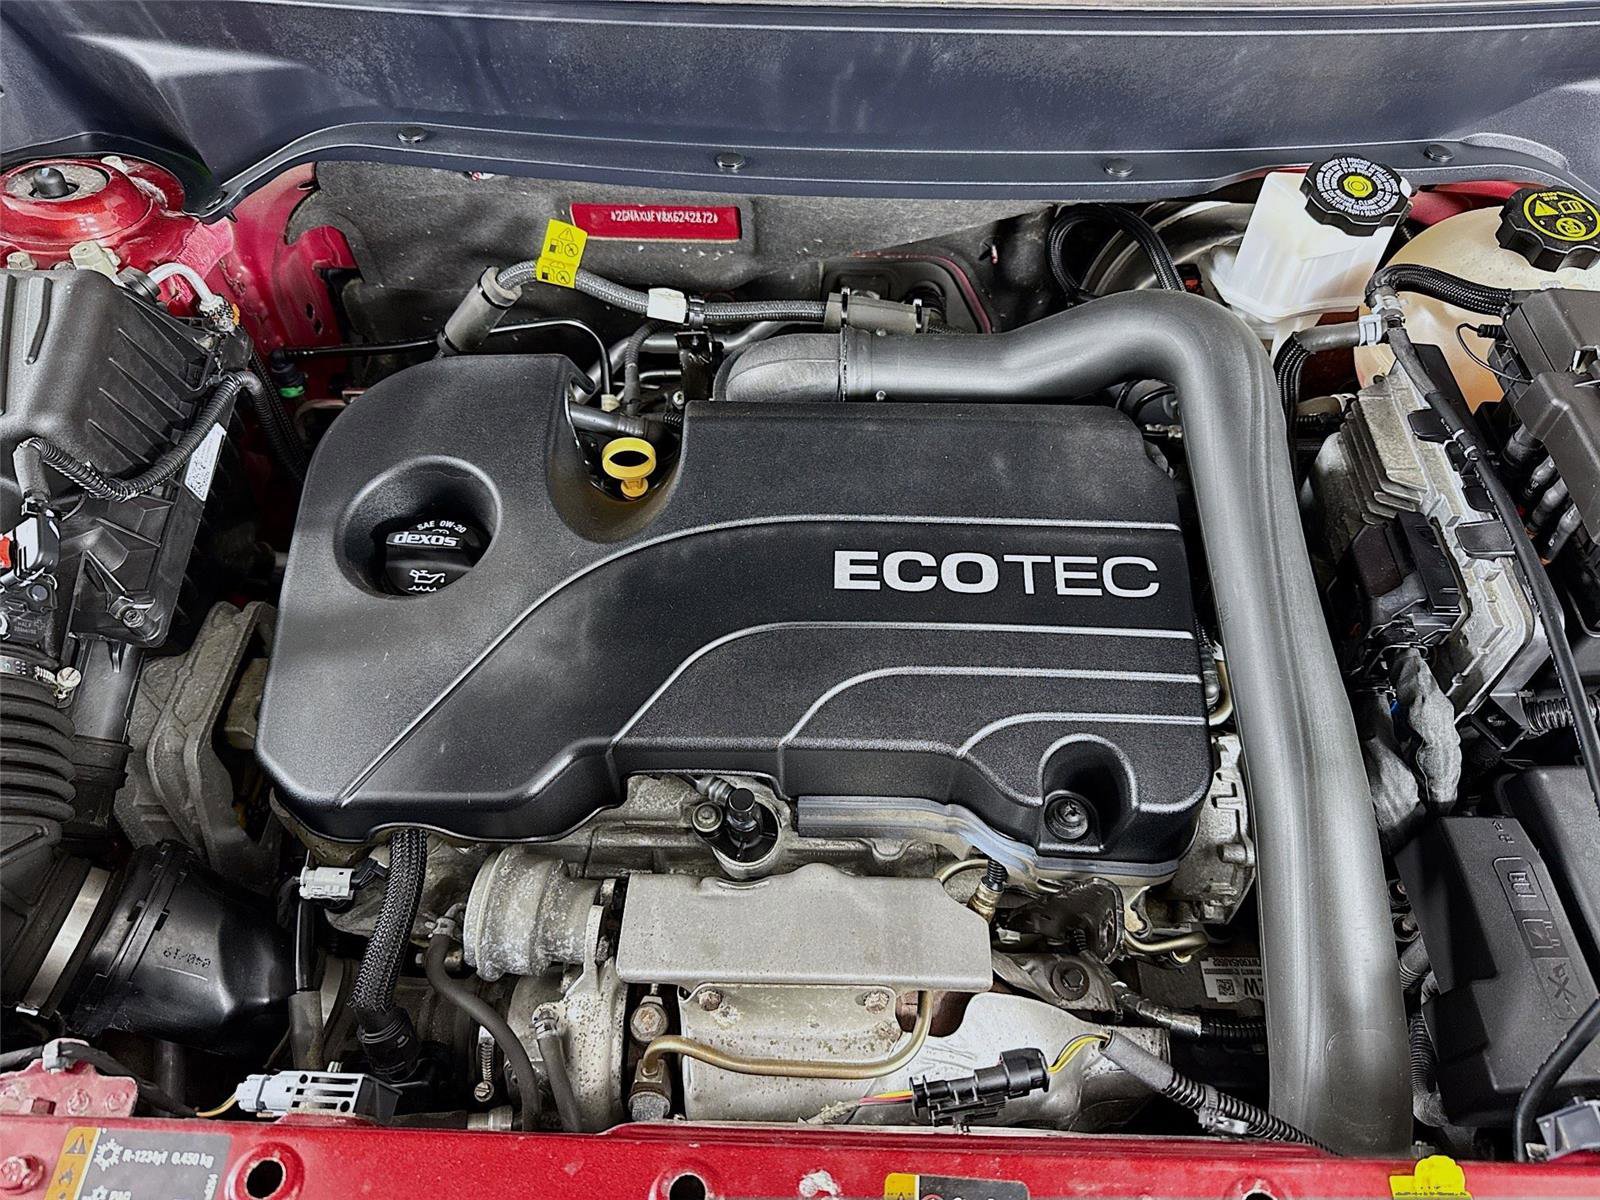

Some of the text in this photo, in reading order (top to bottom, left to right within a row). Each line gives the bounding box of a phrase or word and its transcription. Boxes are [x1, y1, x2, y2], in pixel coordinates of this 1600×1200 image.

[417, 520, 467, 533] SAE 0W-20
[393, 532, 460, 546] dexos
[834, 550, 1160, 597] ECOTEC
